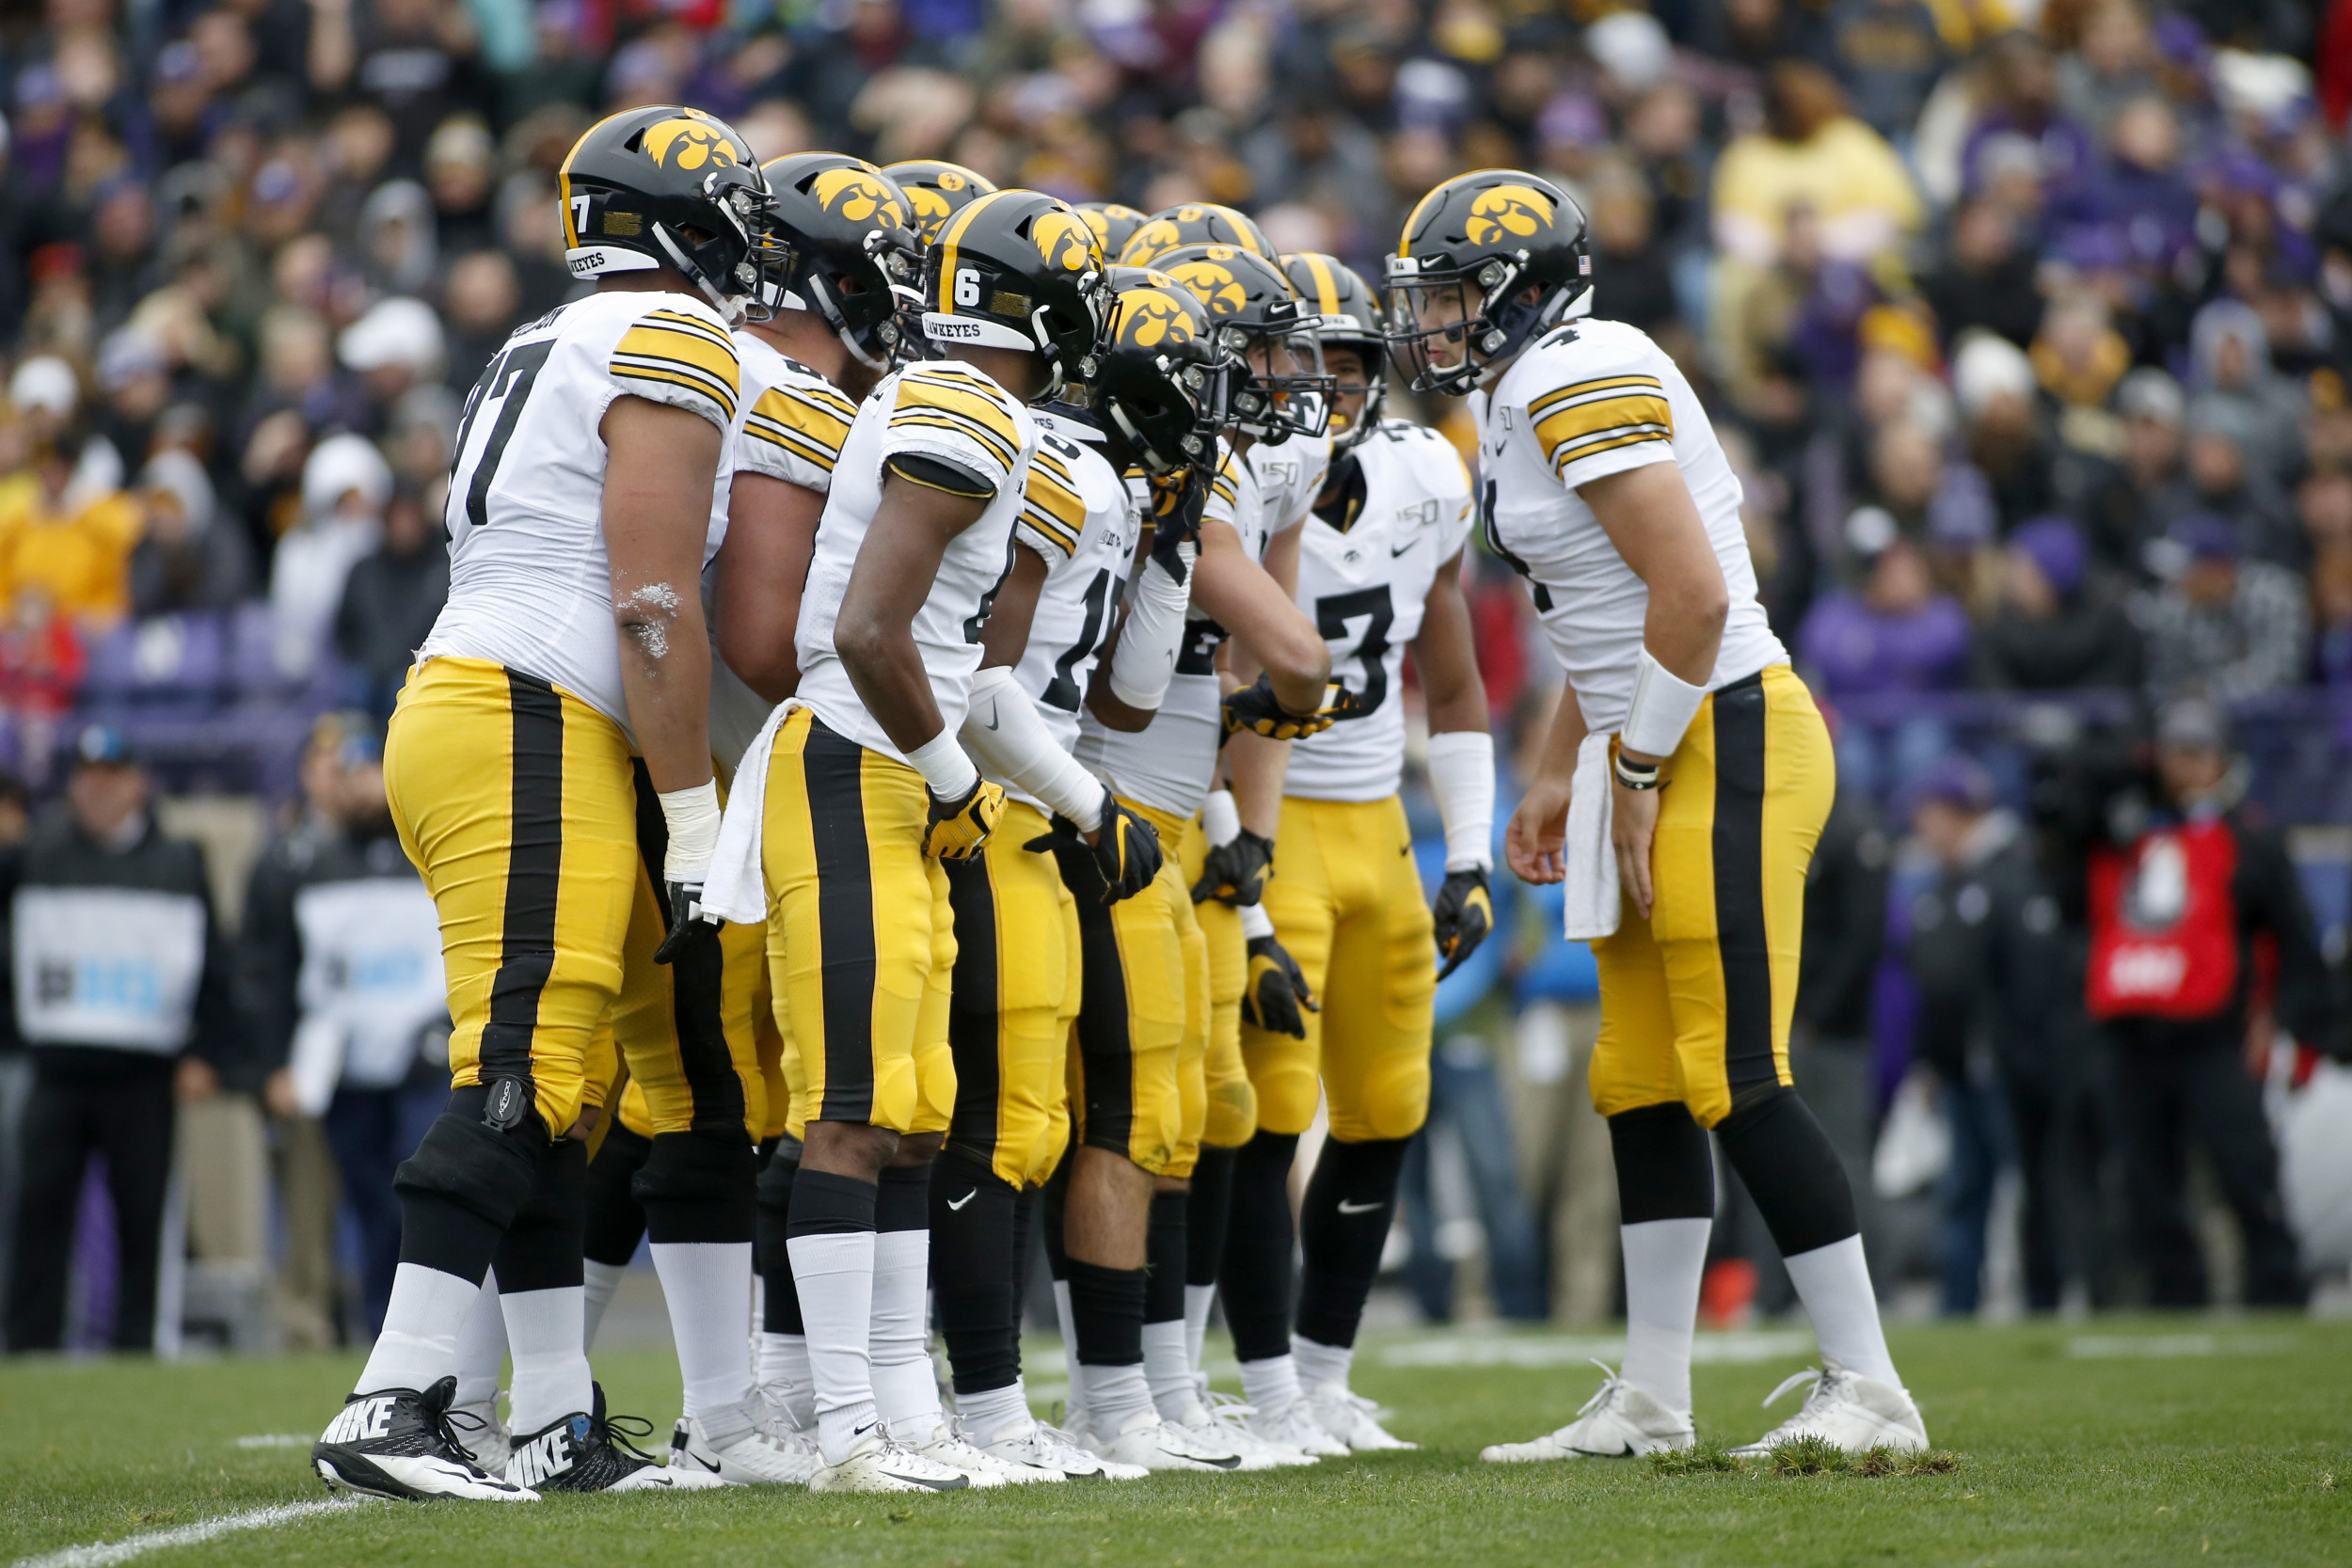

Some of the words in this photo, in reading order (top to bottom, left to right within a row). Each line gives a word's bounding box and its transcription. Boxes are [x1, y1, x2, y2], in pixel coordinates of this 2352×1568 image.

[955, 268, 980, 307] 6
[1315, 582, 1394, 721] 3
[319, 1397, 396, 1444] NIKE
[504, 1425, 573, 1488] NIKE
